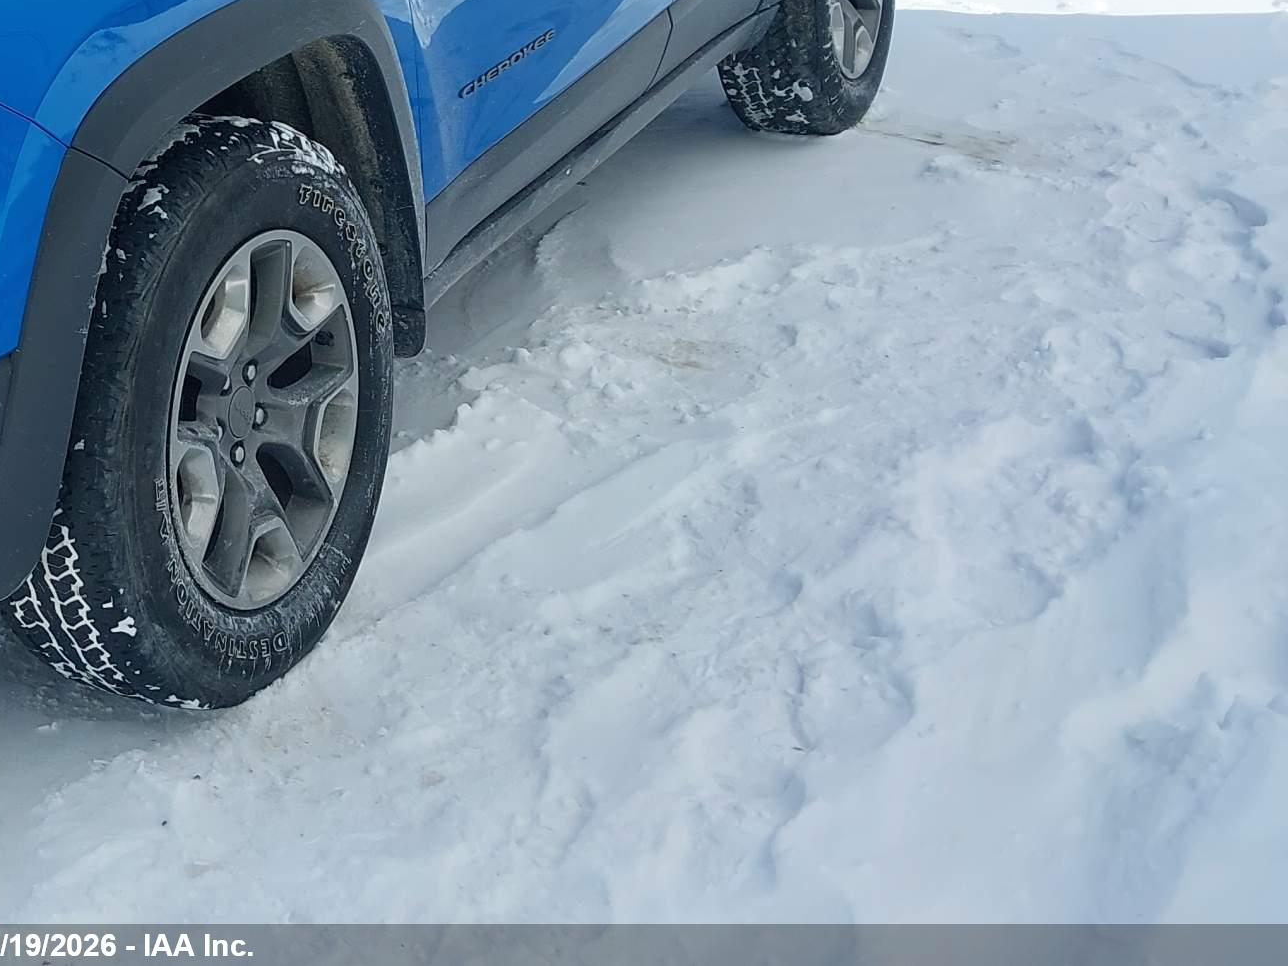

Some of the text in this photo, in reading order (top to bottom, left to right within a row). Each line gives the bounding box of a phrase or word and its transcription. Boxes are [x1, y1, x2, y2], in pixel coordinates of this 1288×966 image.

[457, 27, 557, 100] CHEROKEE
[298, 184, 386, 334] Firestone
[166, 556, 289, 660] DESTINATION
